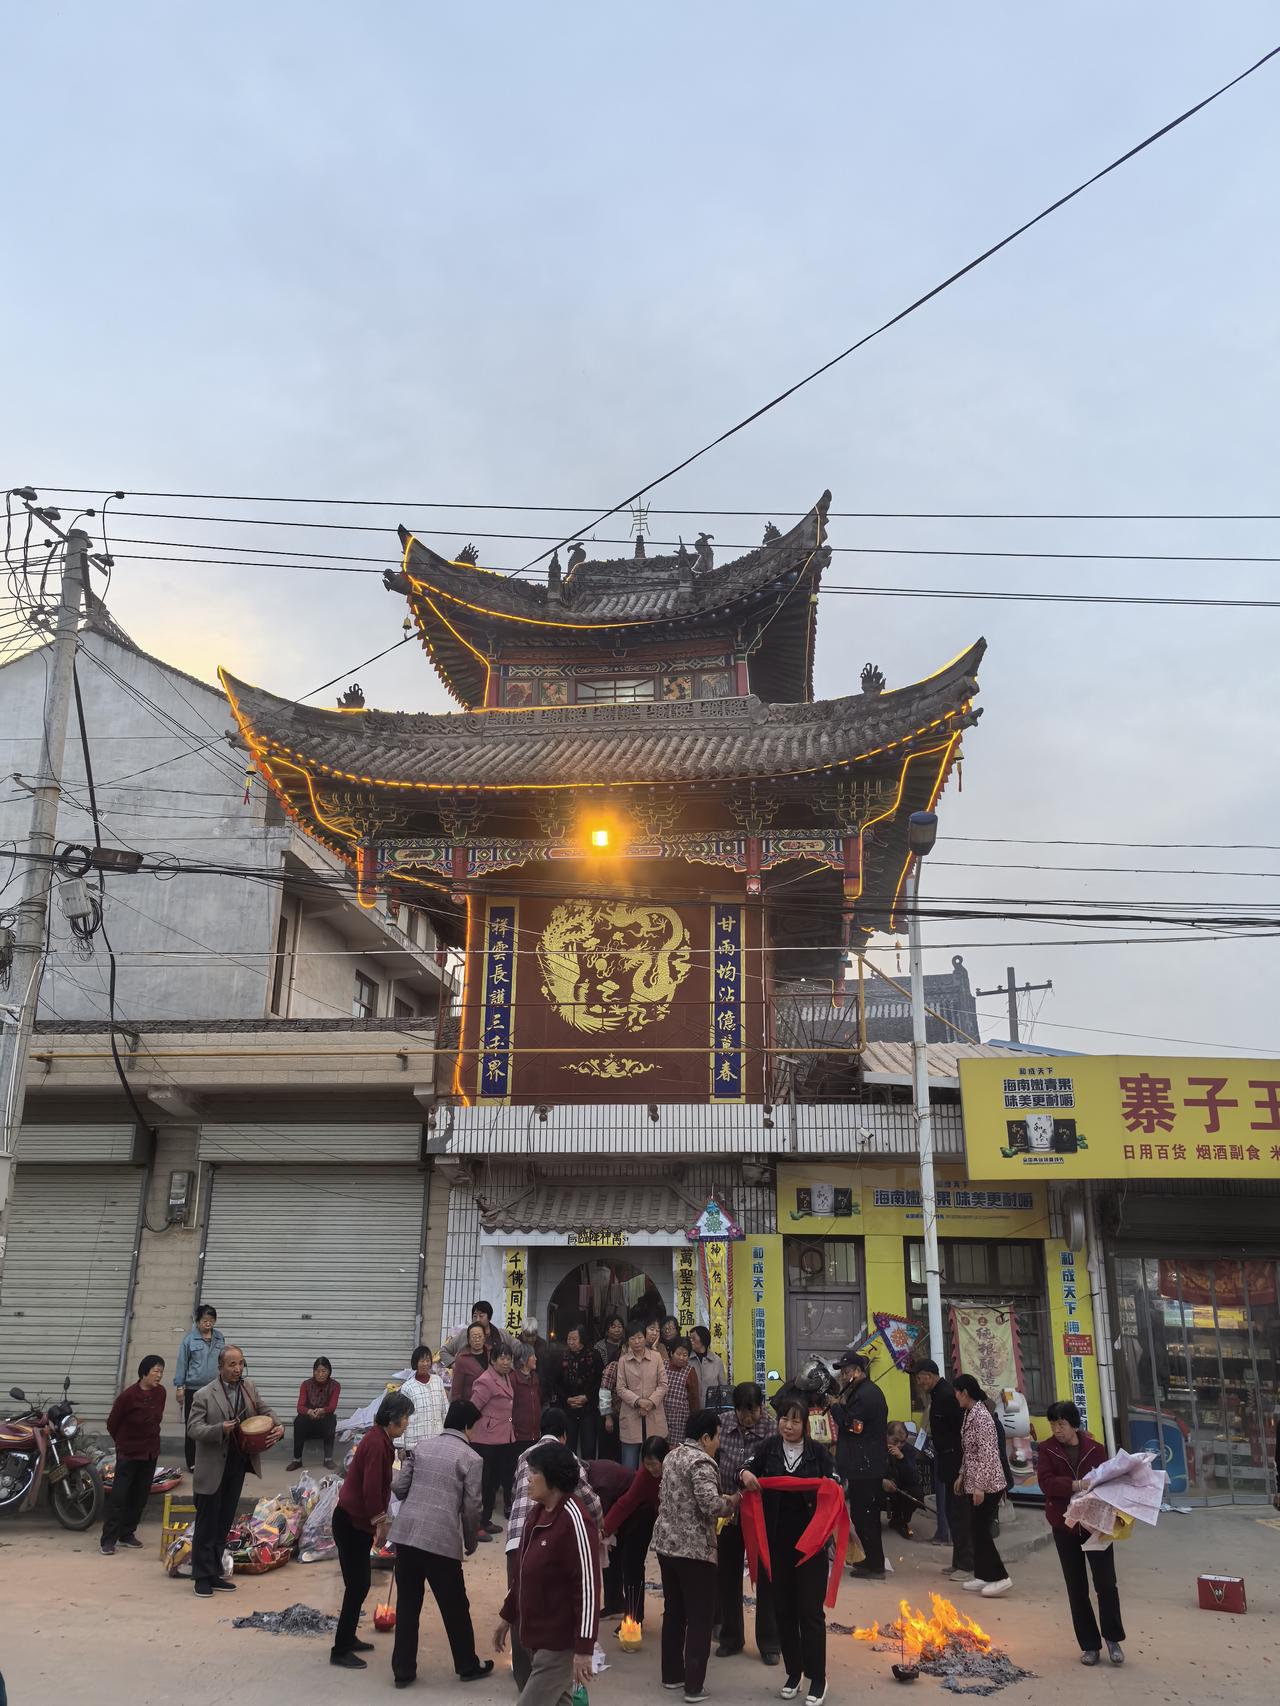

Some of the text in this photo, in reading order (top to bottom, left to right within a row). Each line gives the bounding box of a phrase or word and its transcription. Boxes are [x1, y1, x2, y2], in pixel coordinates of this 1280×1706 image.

[1119, 1072, 1280, 1134] 寨子王
[1123, 1143, 1188, 1161] 日用百货
[1195, 1144, 1261, 1161] 烟酒副食
[679, 1247, 695, 1337] 萬聖齊臨
[1060, 1251, 1077, 1316] 和成天下
